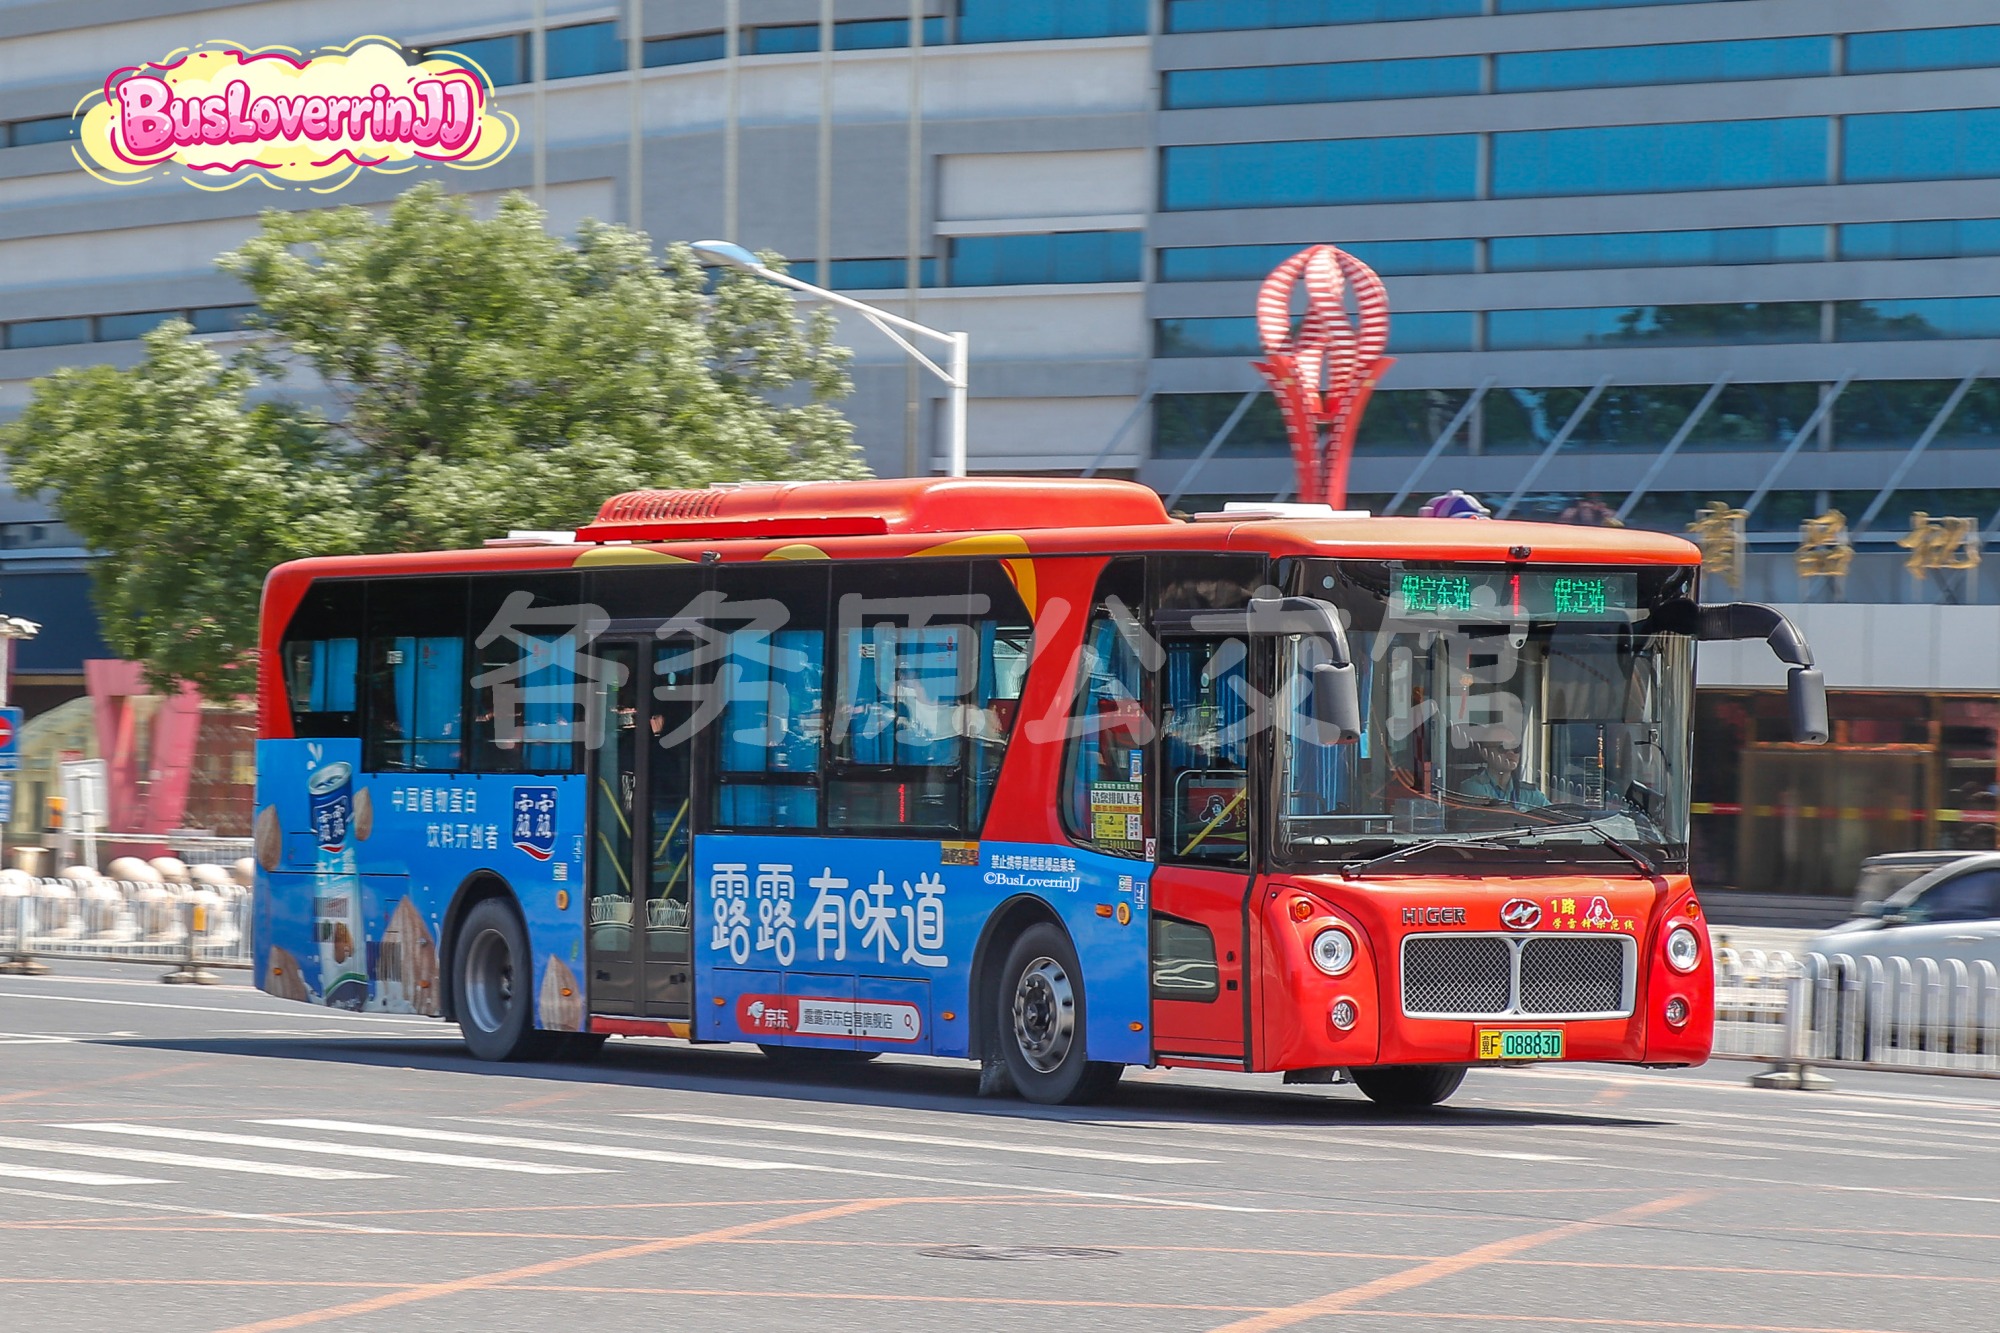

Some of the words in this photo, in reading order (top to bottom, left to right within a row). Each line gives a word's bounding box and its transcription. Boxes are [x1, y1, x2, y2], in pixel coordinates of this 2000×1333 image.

[1401, 575, 1471, 611] 保定东站
[1510, 574, 1521, 616] 1
[1554, 578, 1605, 613] 保定站
[391, 786, 477, 813] 中国植物蛋白
[1092, 792, 1141, 805] 请您排队上车
[426, 822, 499, 850] 饮料开创者
[991, 854, 1077, 873] 禁止携带易燃易爆品乘车
[710, 863, 949, 968] 露露有味道
[1402, 907, 1467, 926] HIGER
[1550, 897, 1576, 916] 1路
[1551, 917, 1636, 931] 学雷锋示范线
[764, 1009, 790, 1029] 京东
[803, 1008, 893, 1030] 露露京东自营旗舰店
